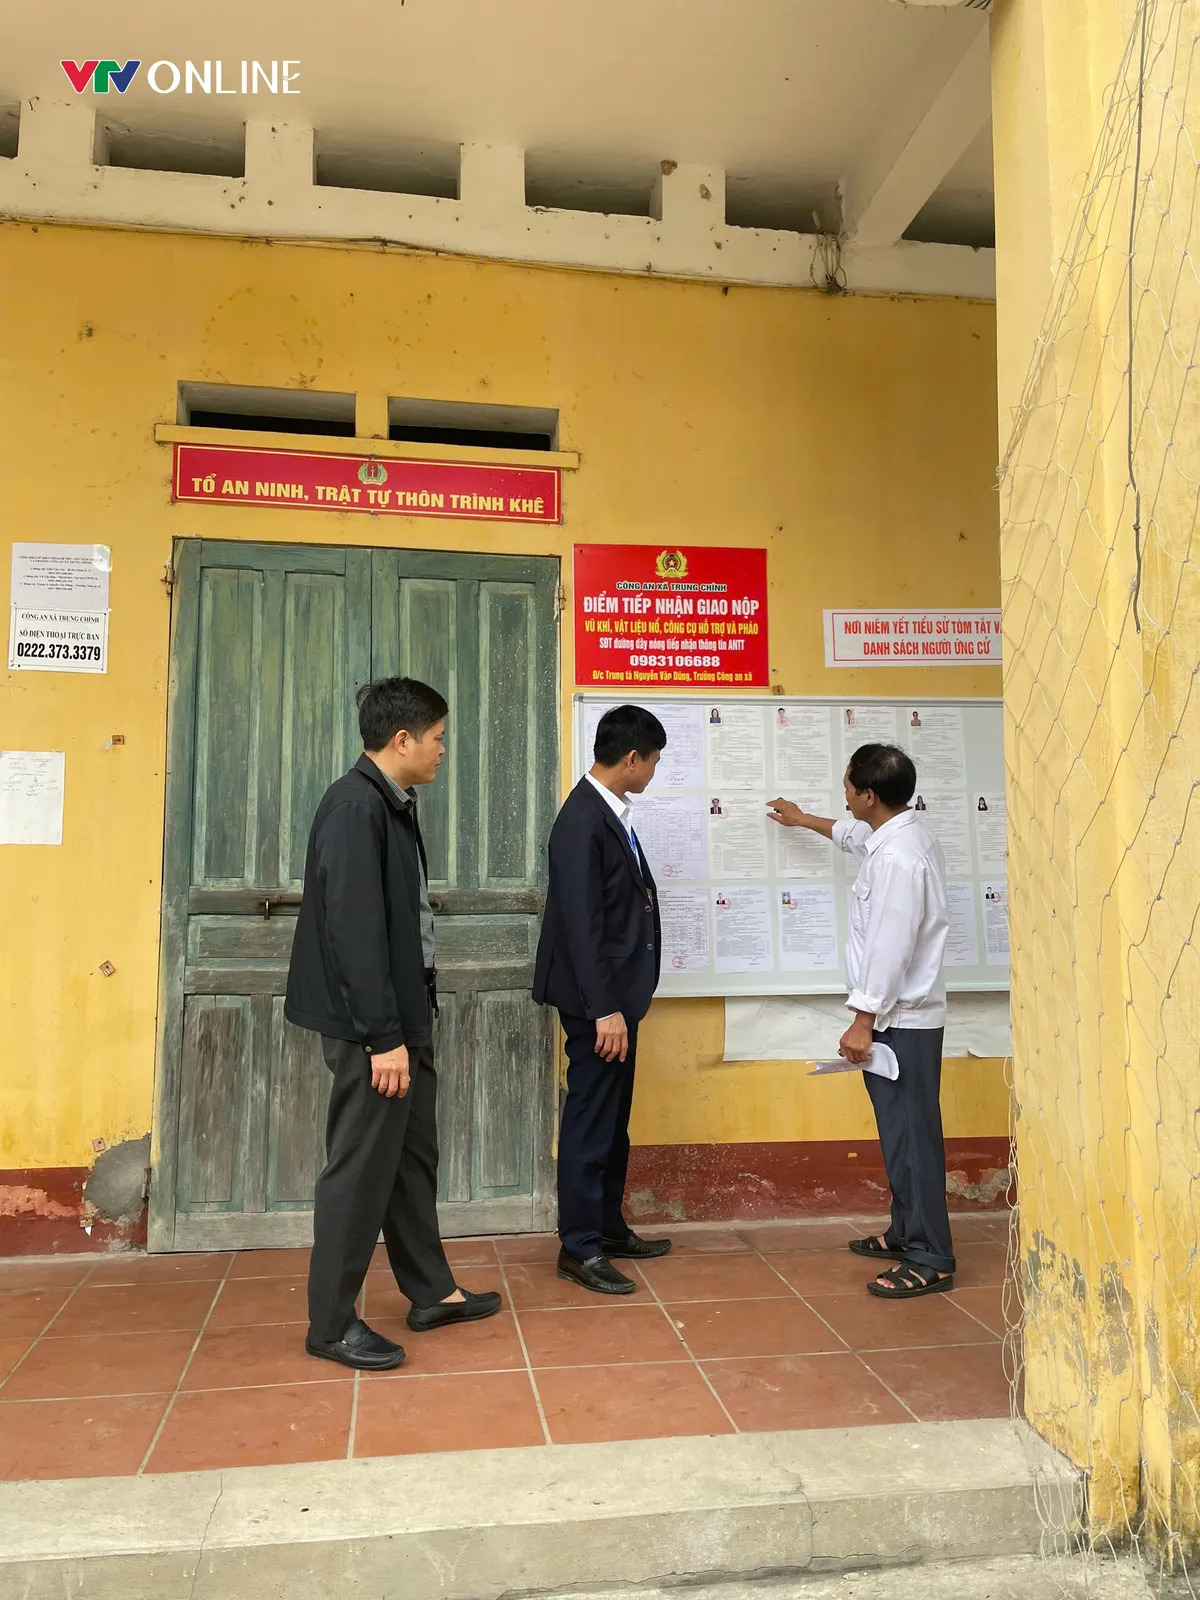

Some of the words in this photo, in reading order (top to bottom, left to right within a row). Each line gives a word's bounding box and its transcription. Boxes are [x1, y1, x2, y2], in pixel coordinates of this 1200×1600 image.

[192, 473, 216, 492] TỔ
[222, 480, 248, 495] AN
[256, 482, 309, 501] NINH,
[315, 485, 361, 504] TRẬT
[367, 490, 392, 507] TỰ
[396, 490, 444, 508] THÔN
[450, 493, 504, 511] TRÌNH
[510, 497, 544, 513] KHÊ
[616, 580, 640, 590] CÔNG
[656, 582, 668, 591] XÃ
[700, 583, 726, 592] CHÍNH
[584, 591, 618, 613] ĐIỂM
[622, 593, 651, 614] TIẾP
[656, 595, 693, 618] NHẬN
[697, 599, 728, 615] GIAO
[732, 597, 759, 618] NỘP
[585, 618, 595, 632] VŨ
[597, 618, 612, 634] KHÍ,
[614, 618, 628, 635] VẬT
[630, 619, 646, 635] LIỆU
[649, 618, 662, 635] NỔ,
[664, 620, 685, 634] CÔNG
[686, 622, 696, 635] CỤ
[699, 618, 709, 634] HỖ
[711, 622, 725, 636] TRỢ
[726, 620, 737, 634] VÀ
[739, 620, 758, 634] PHÁO
[844, 620, 861, 634] NƠI
[864, 618, 889, 634] NIÊM
[893, 616, 909, 634] YẾT
[912, 616, 932, 634] TIỂU
[936, 616, 950, 634] SỬ
[952, 618, 971, 634] TÓM
[974, 616, 990, 634] TẮT
[994, 621, 1002, 633] V
[46, 631, 66, 640] THOẠI
[68, 632, 85, 641] TRỰC
[667, 637, 679, 650] tiếp
[681, 639, 697, 651] nhận
[718, 640, 726, 650] tin
[728, 640, 744, 650] ANTT
[17, 642, 100, 661] 0222.373.3379
[864, 641, 889, 655] DANH
[893, 638, 918, 655] SÁCH
[922, 638, 951, 655] NGƯỜI
[954, 638, 974, 654] ỨNG
[978, 636, 991, 654] CỬ
[630, 655, 720, 666] 0983106688
[606, 670, 624, 681] Trung
